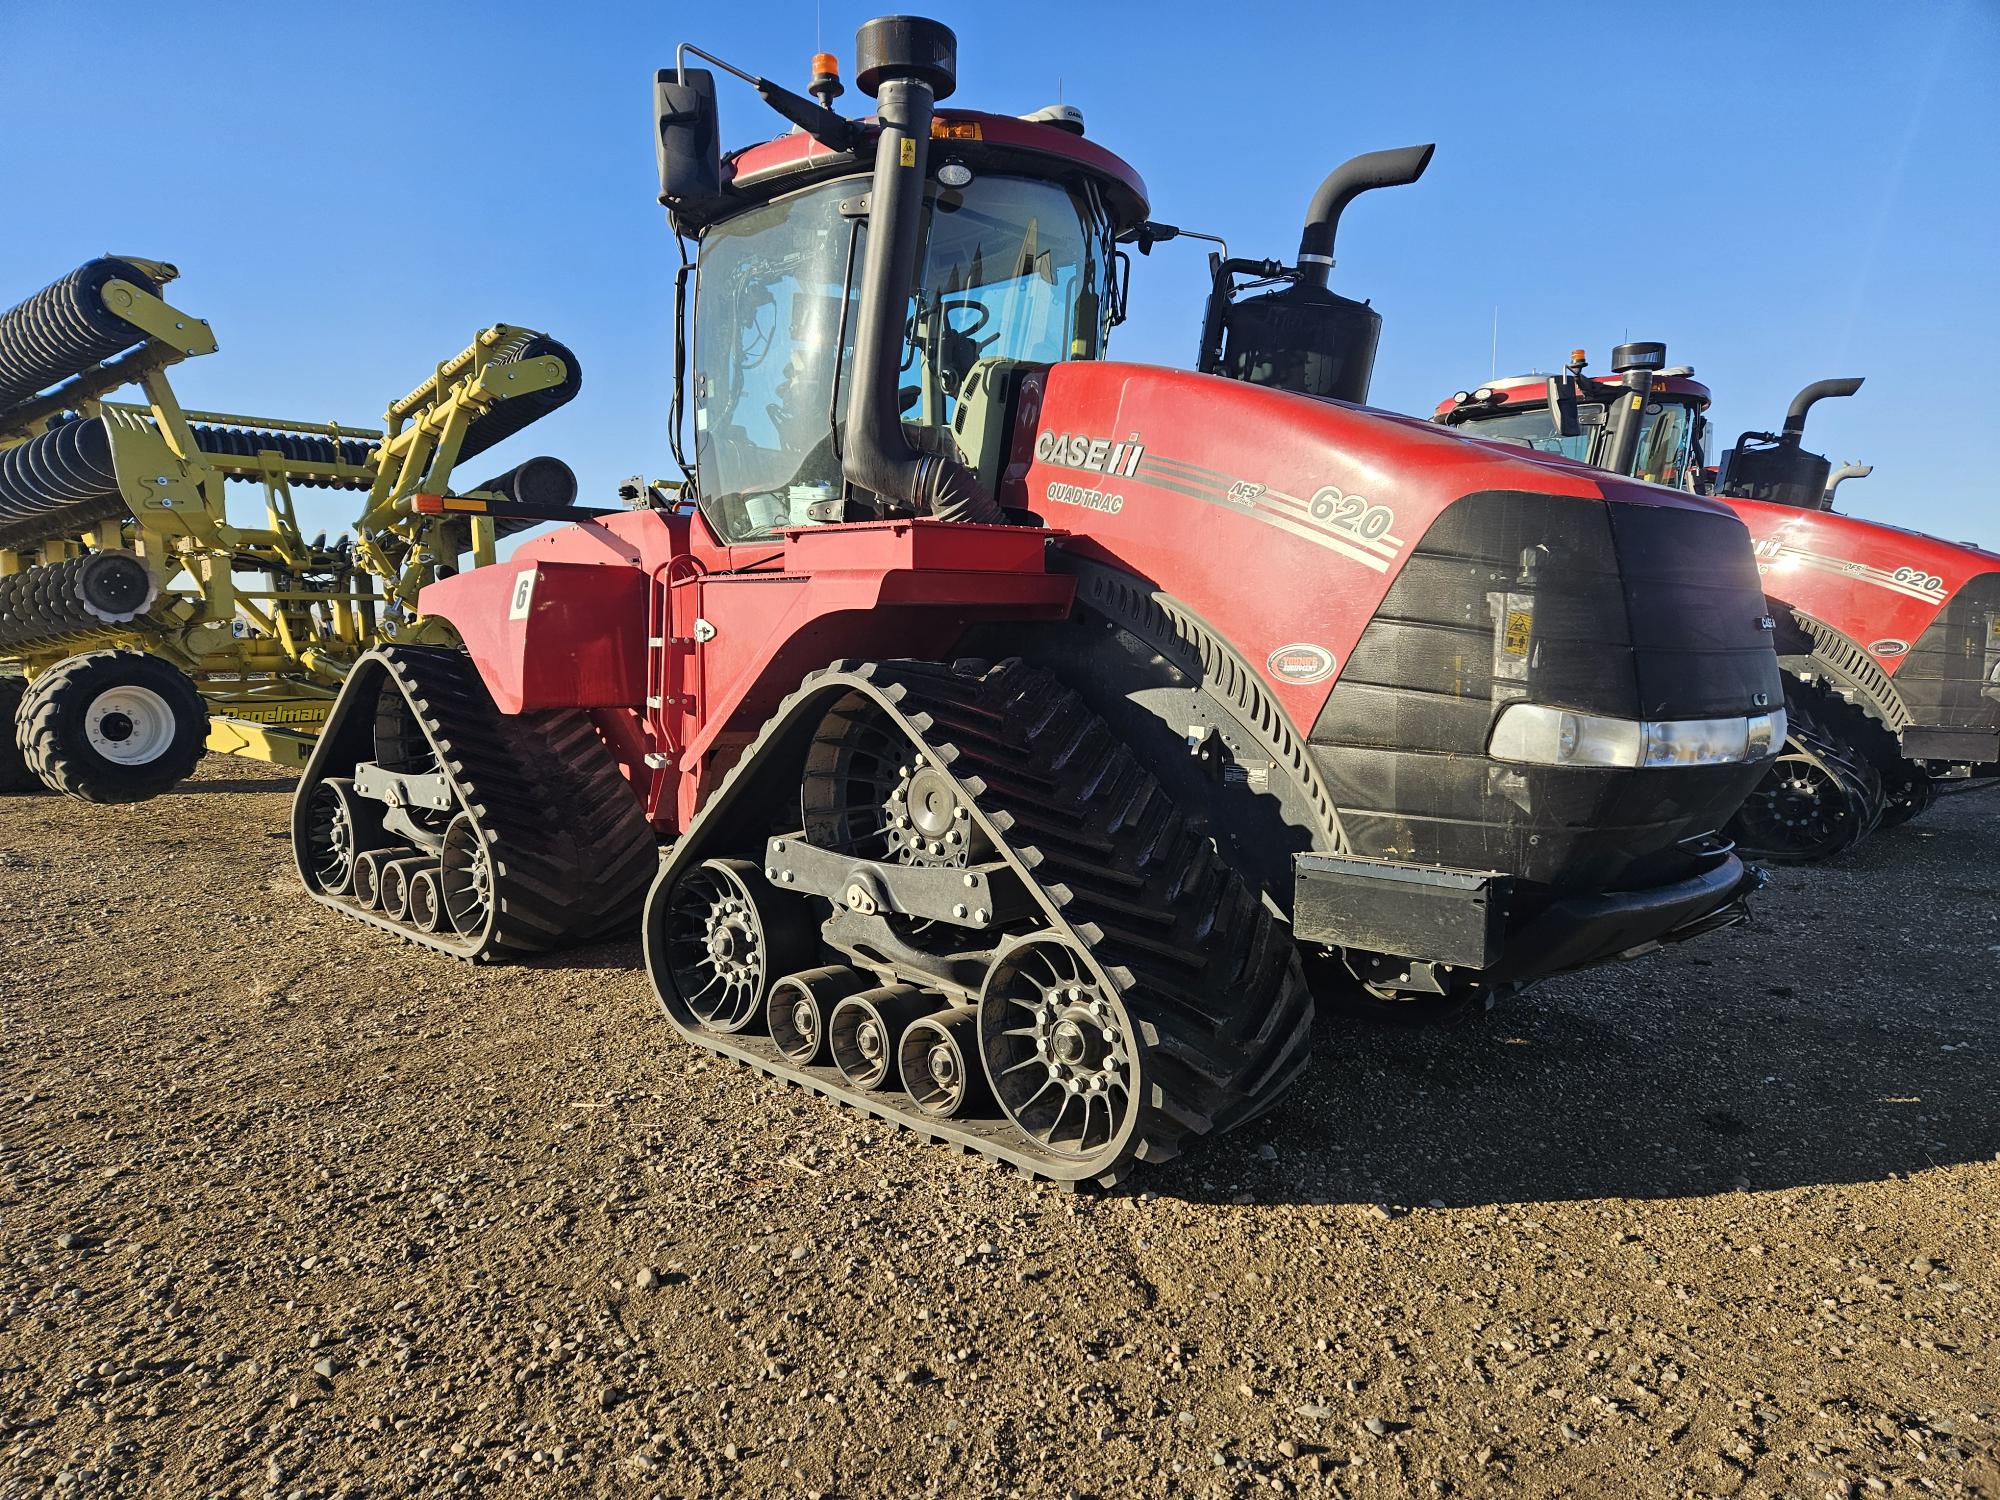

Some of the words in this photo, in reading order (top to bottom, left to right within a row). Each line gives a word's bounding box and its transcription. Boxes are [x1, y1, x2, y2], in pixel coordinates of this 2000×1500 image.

[1035, 430, 1111, 472] CASE
[1047, 482, 1124, 514] QUADTRAC
[1229, 480, 1259, 498] AFS
[1308, 486, 1394, 541] 620
[515, 579, 529, 610] 6
[1893, 566, 1943, 592] 620
